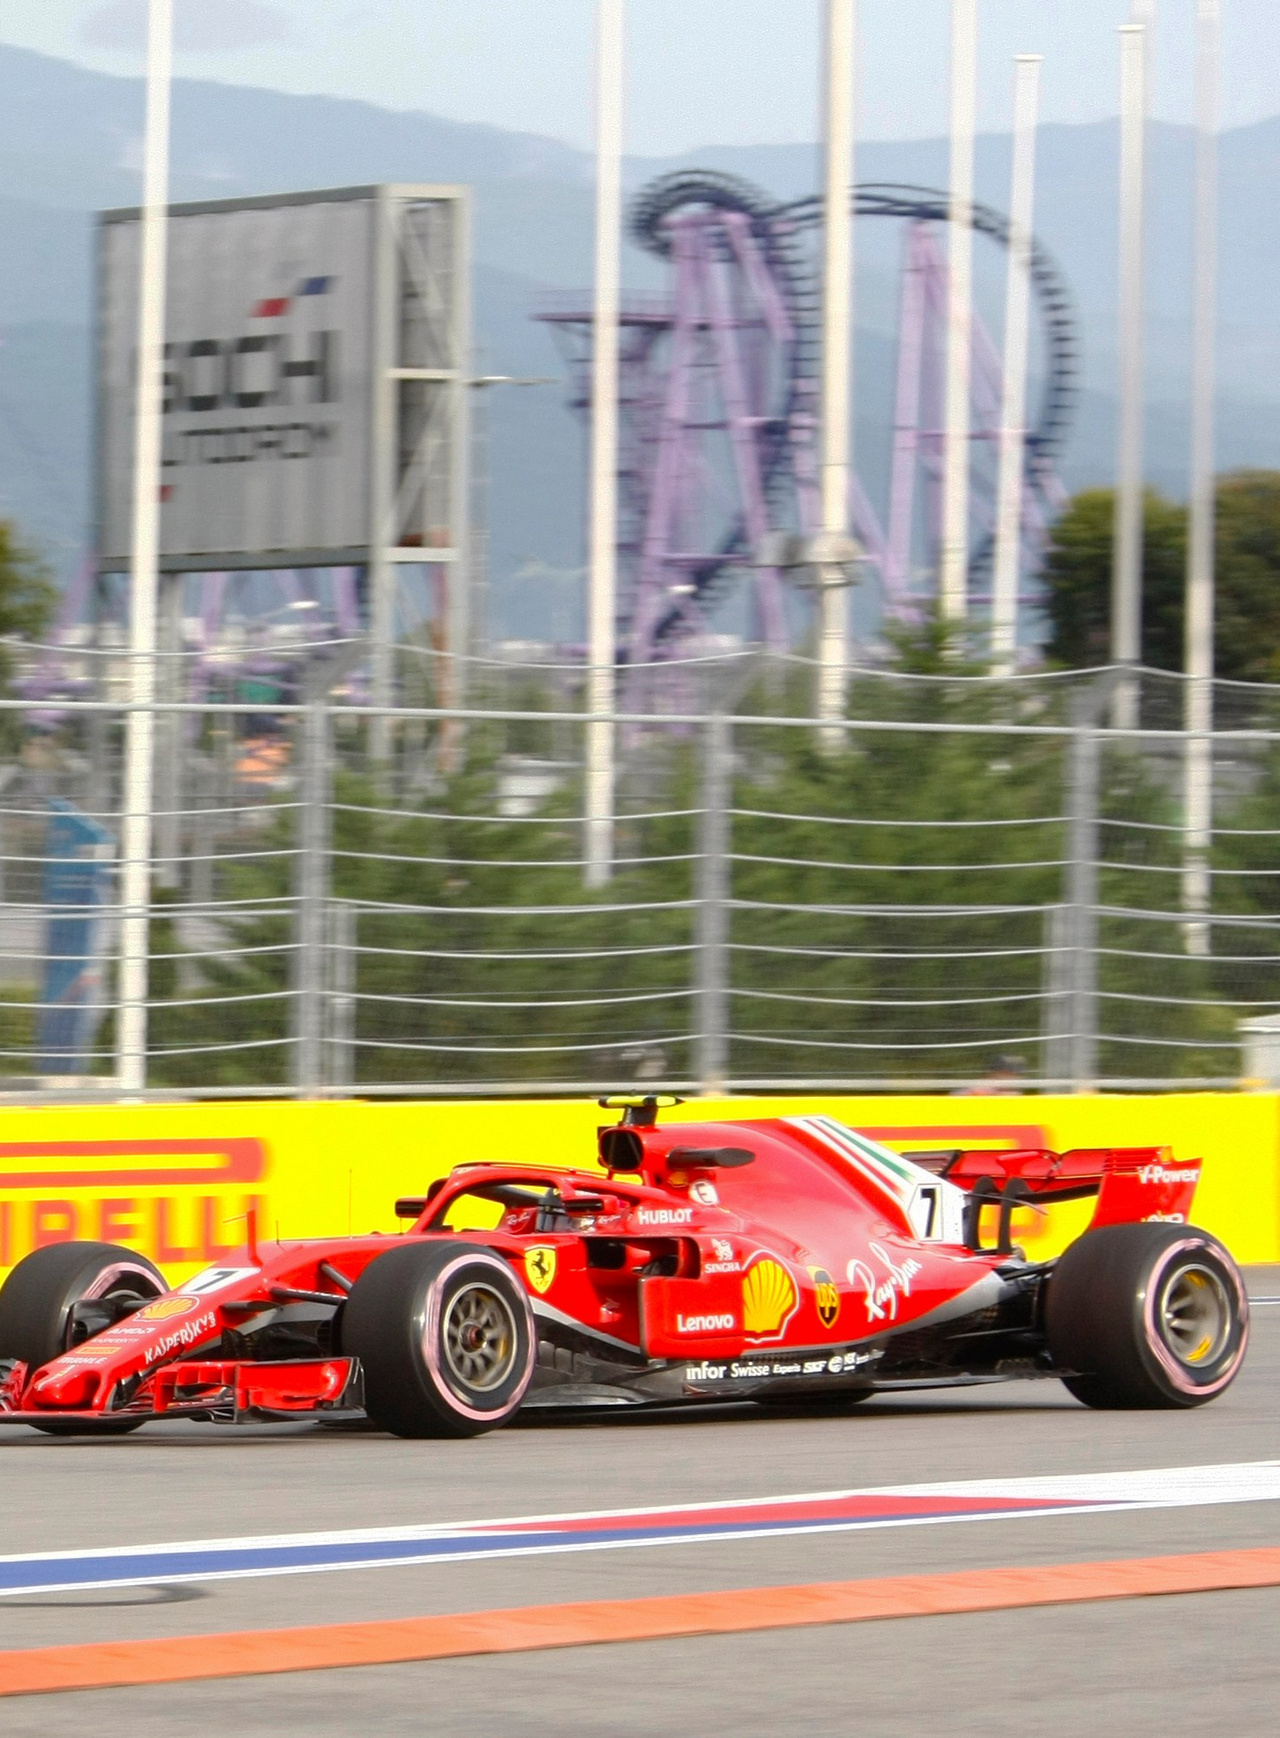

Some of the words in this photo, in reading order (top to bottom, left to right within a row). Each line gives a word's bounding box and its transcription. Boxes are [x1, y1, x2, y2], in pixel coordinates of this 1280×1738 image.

[638, 1207, 694, 1225] HUBLOT
[920, 1188, 936, 1238] 7
[704, 1262, 741, 1274] SINGHA
[677, 1314, 734, 1332] Lenovo
[144, 1314, 209, 1365] KASPERSKY
[731, 1362, 770, 1378] Swisse
